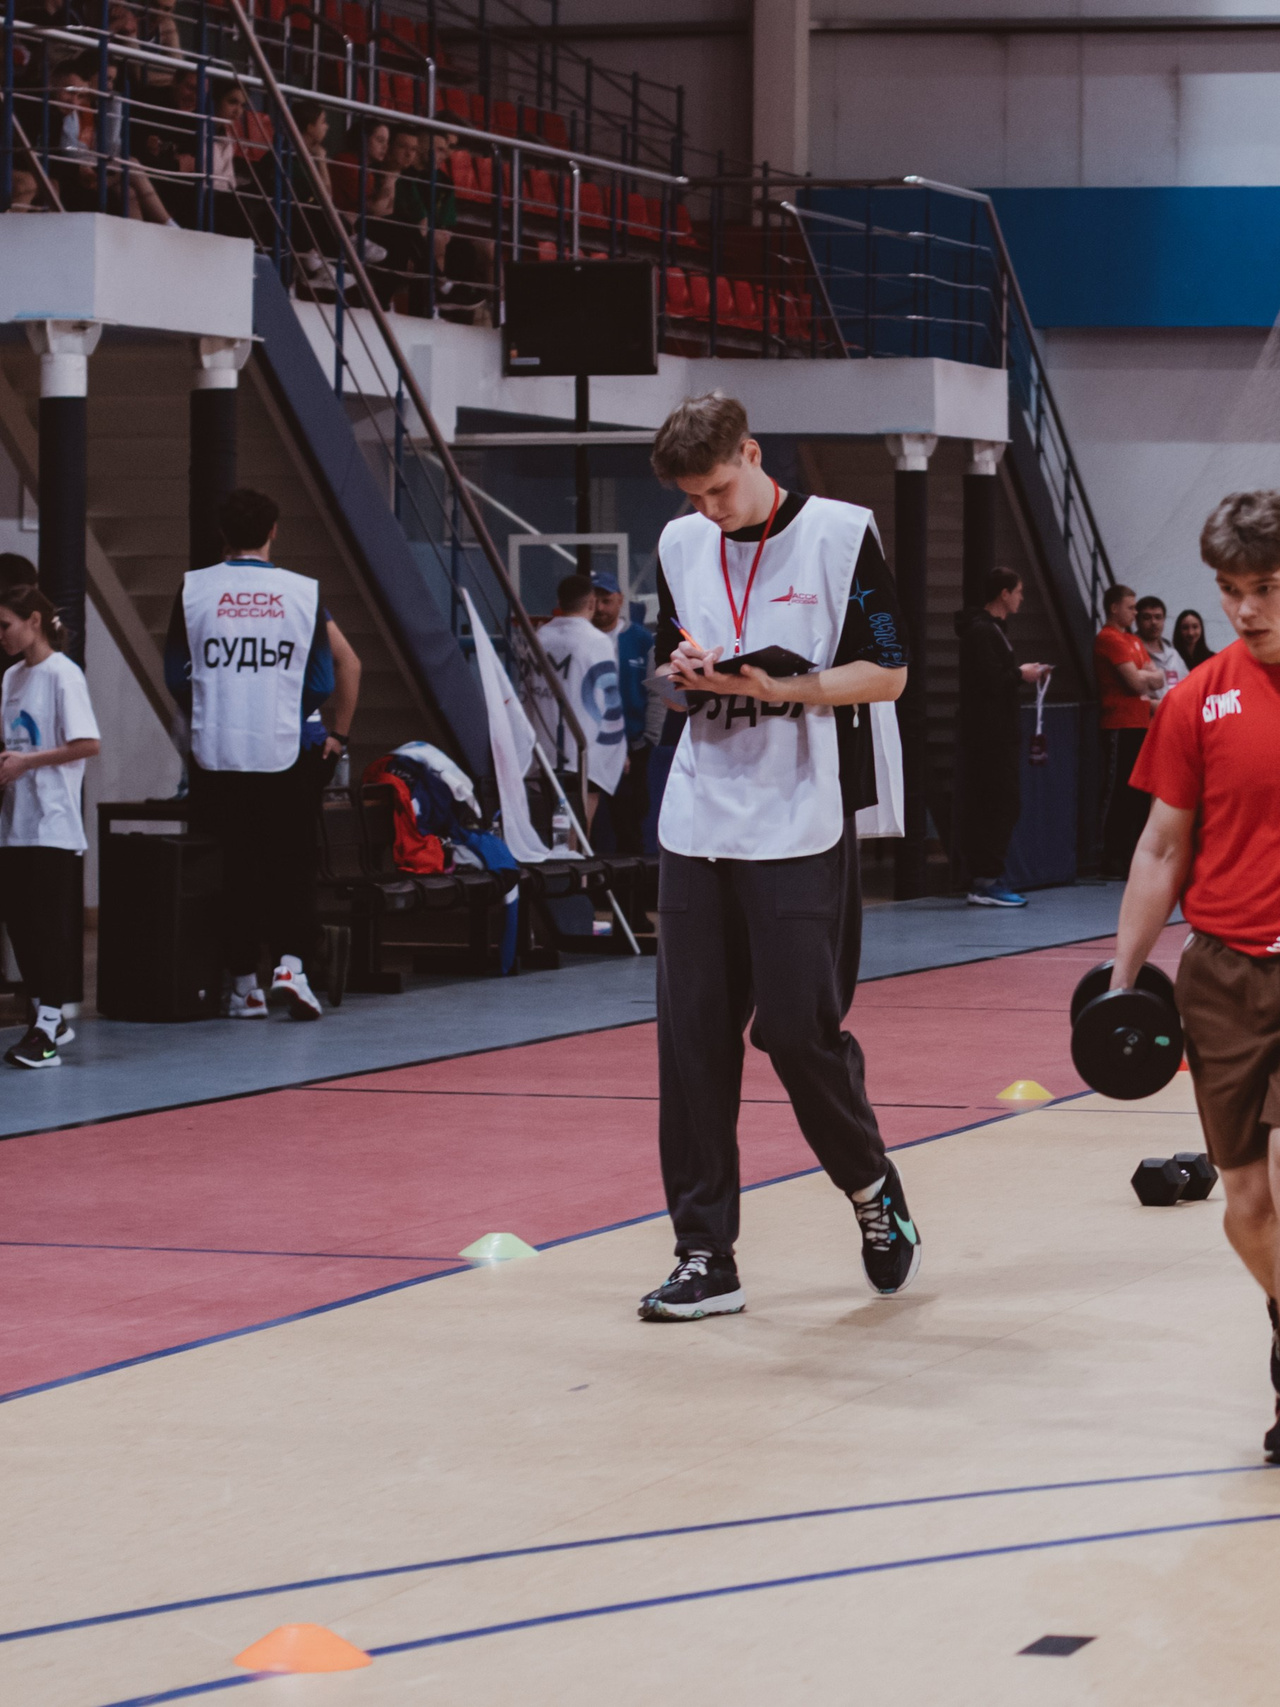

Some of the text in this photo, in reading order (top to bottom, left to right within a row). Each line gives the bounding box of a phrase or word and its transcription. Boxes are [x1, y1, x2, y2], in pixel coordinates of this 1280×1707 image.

[218, 592, 284, 607] АССК
[216, 607, 285, 619] РОССИИ
[204, 637, 295, 673] СУДЬЯ
